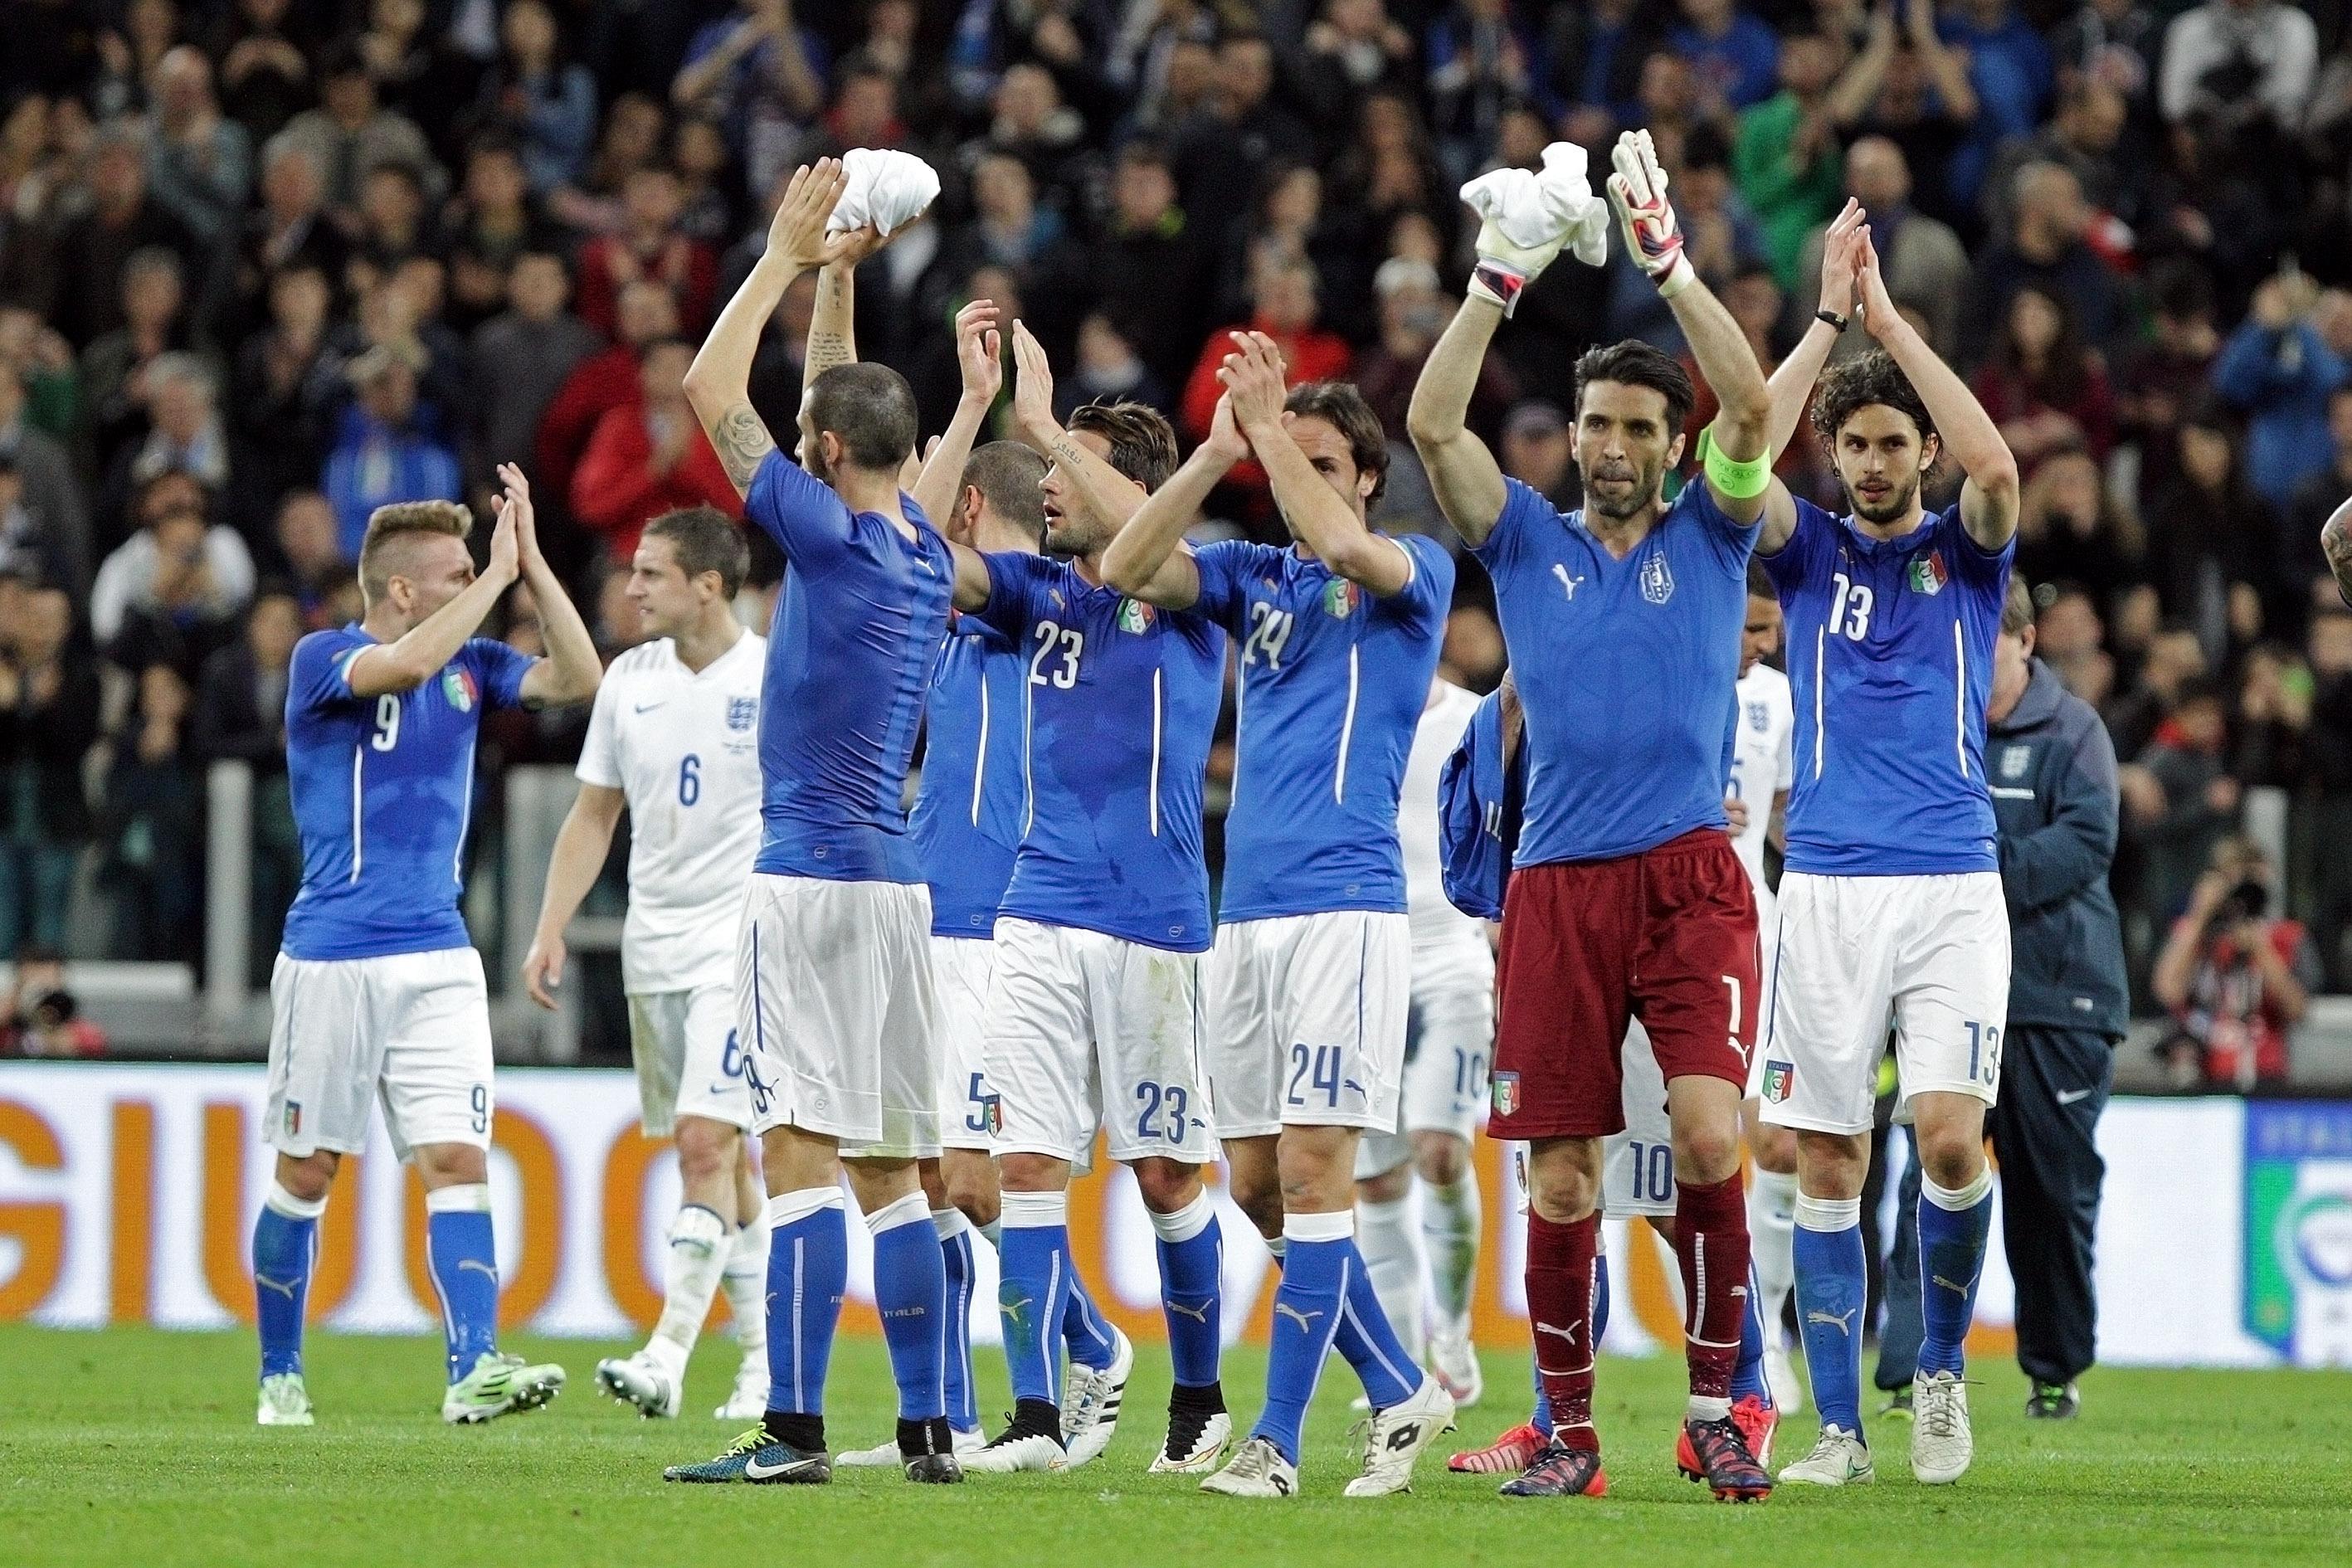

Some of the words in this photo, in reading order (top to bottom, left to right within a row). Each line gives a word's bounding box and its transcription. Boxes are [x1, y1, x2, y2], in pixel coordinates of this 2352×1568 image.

[1244, 601, 1293, 670] 24
[1829, 572, 1874, 642] 13
[1030, 620, 1083, 689] 23
[371, 692, 401, 752] 9
[679, 752, 701, 807] 6
[1721, 974, 1741, 1035] 1
[722, 1025, 743, 1078] 6
[1287, 1043, 1342, 1108] 24
[1964, 1020, 1999, 1086] 13
[471, 1083, 487, 1134] 9
[966, 1072, 987, 1132] 5
[1137, 1081, 1187, 1145] 23
[1629, 1140, 1673, 1202] 10
[884, 1307, 925, 1318] ITALIA
